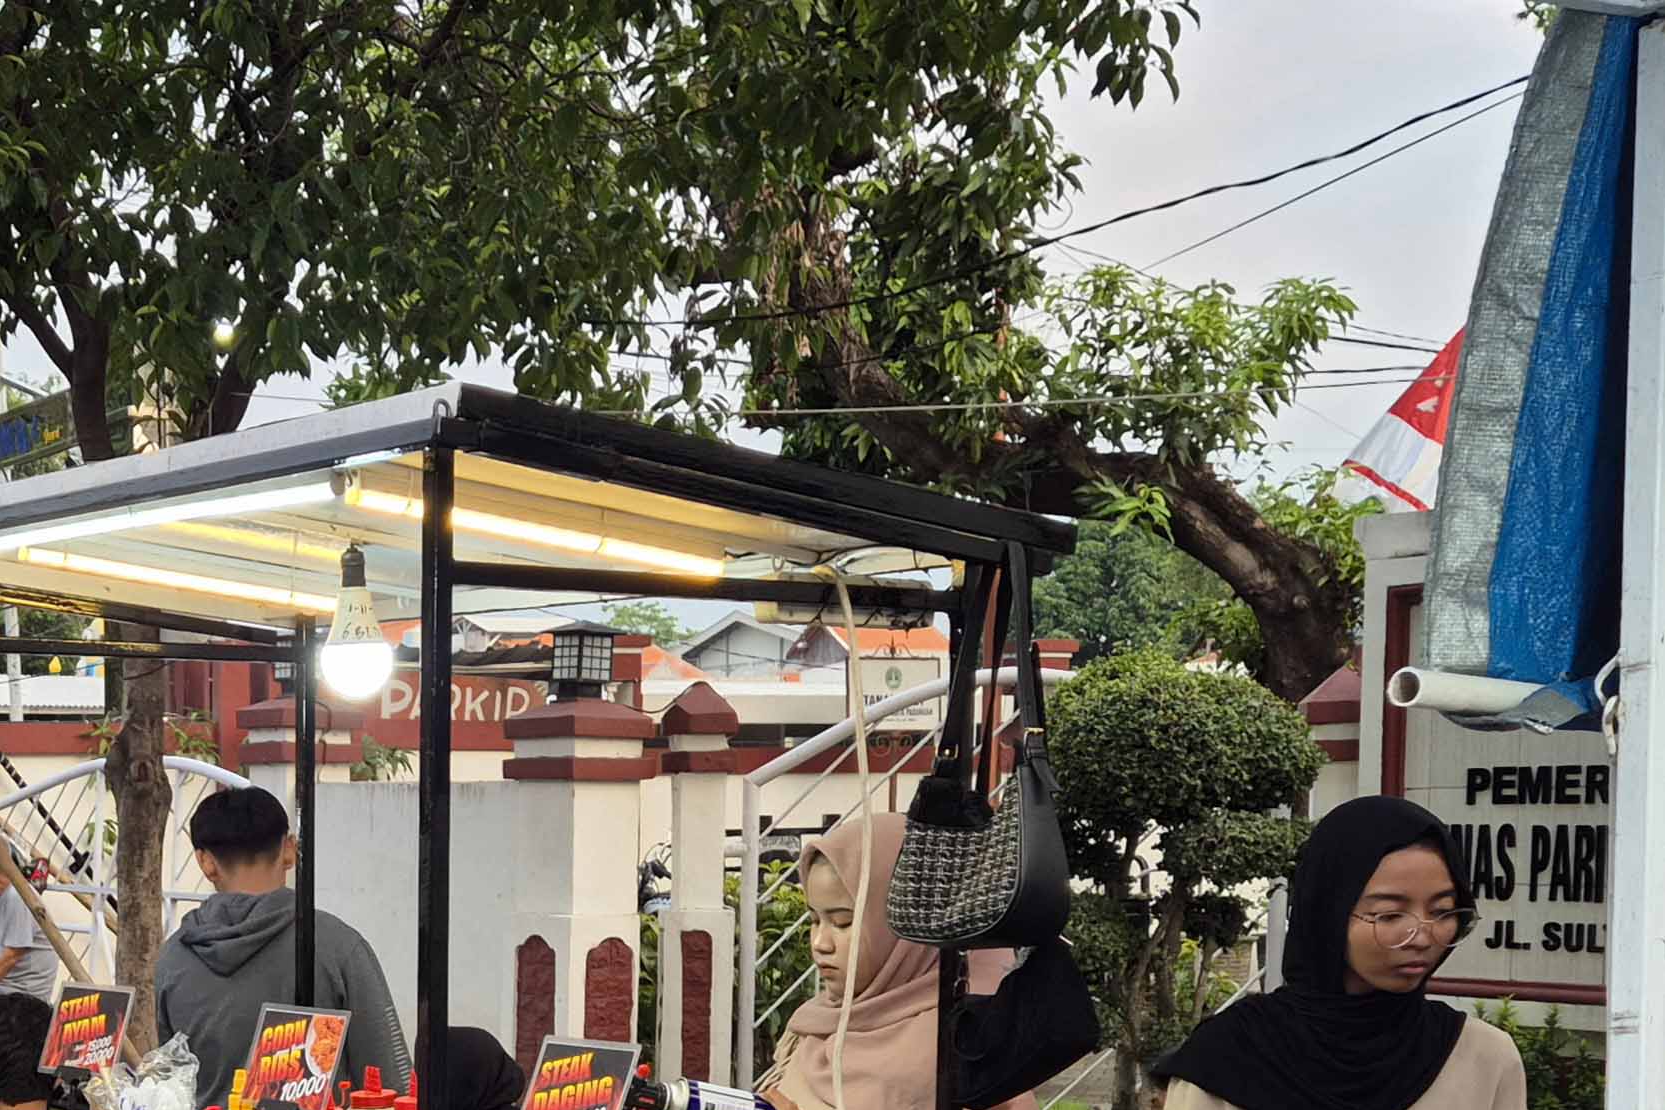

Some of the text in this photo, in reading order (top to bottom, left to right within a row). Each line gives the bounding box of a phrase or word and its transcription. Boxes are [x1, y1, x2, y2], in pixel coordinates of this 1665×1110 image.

[1466, 765, 1610, 805] PEMER
[1485, 920, 1607, 953] JL. SUL
[60, 992, 100, 1021] STEAK
[62, 1013, 107, 1044] AYAM
[260, 1019, 307, 1053] CORN
[258, 1049, 304, 1084] RIBS
[539, 1051, 594, 1086] STEAK
